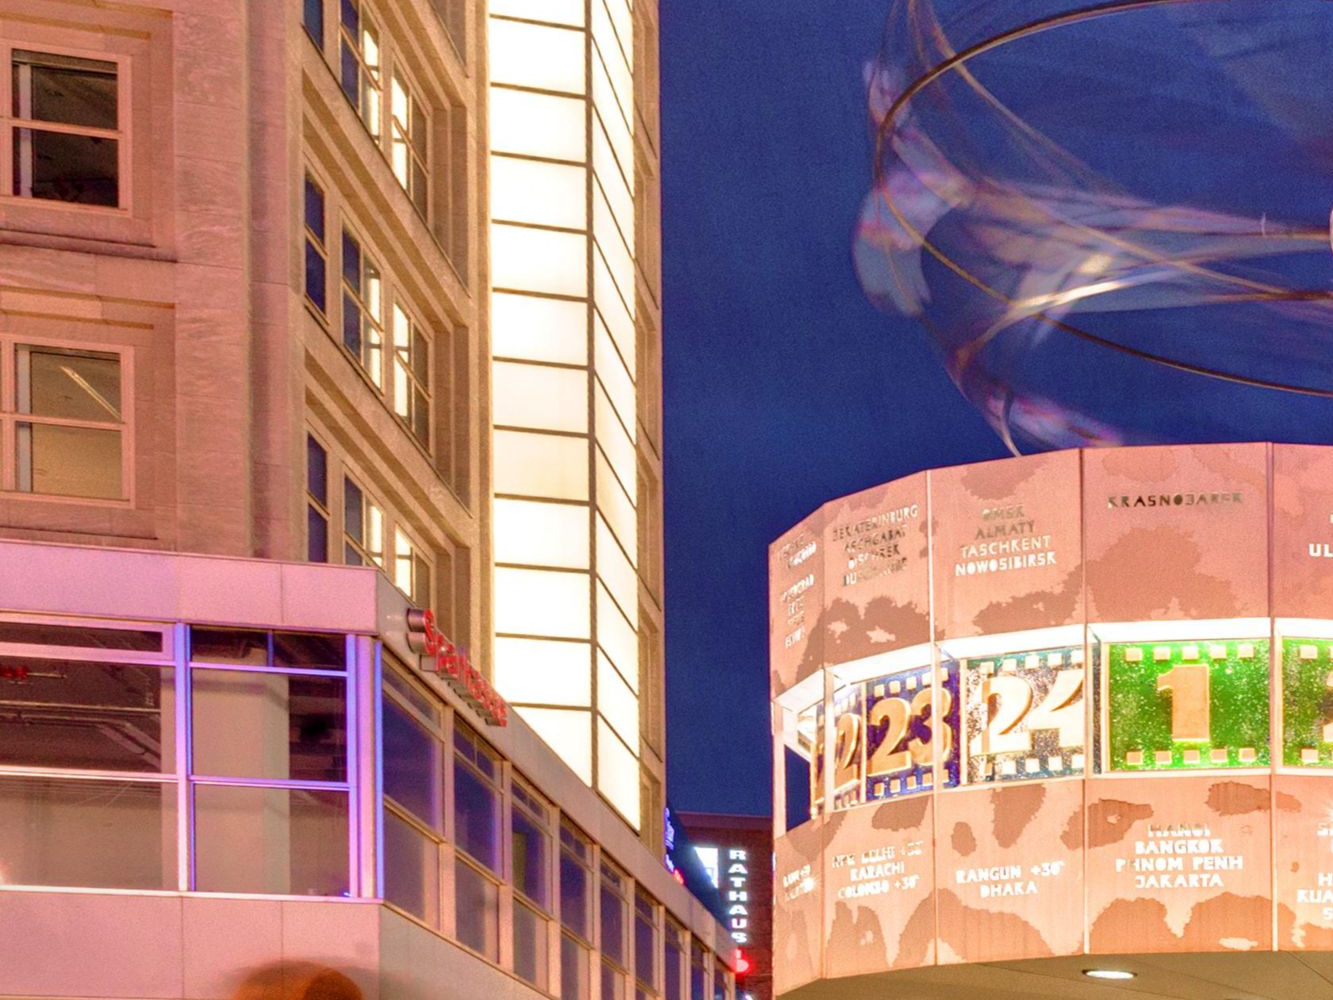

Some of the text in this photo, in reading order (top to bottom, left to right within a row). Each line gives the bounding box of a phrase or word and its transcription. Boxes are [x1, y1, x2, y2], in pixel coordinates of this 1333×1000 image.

[982, 504, 1025, 521] OMSK
[975, 519, 1034, 540] ALMATY
[960, 534, 1052, 558] TASCHKENT
[955, 551, 1057, 577] NOWOSIBIRSK
[970, 668, 1085, 756] 24
[1156, 664, 1211, 743] 1
[867, 686, 952, 777] 23
[1135, 838, 1224, 855] BANGKOK
[850, 861, 905, 882] KARACHI
[955, 863, 1022, 884] RANGUN
[1115, 855, 1243, 873] PHNOM PENH
[980, 881, 1038, 898] DHAKA
[1135, 873, 1225, 889] JAKARTA
[728, 849, 748, 944] RATHAUS
